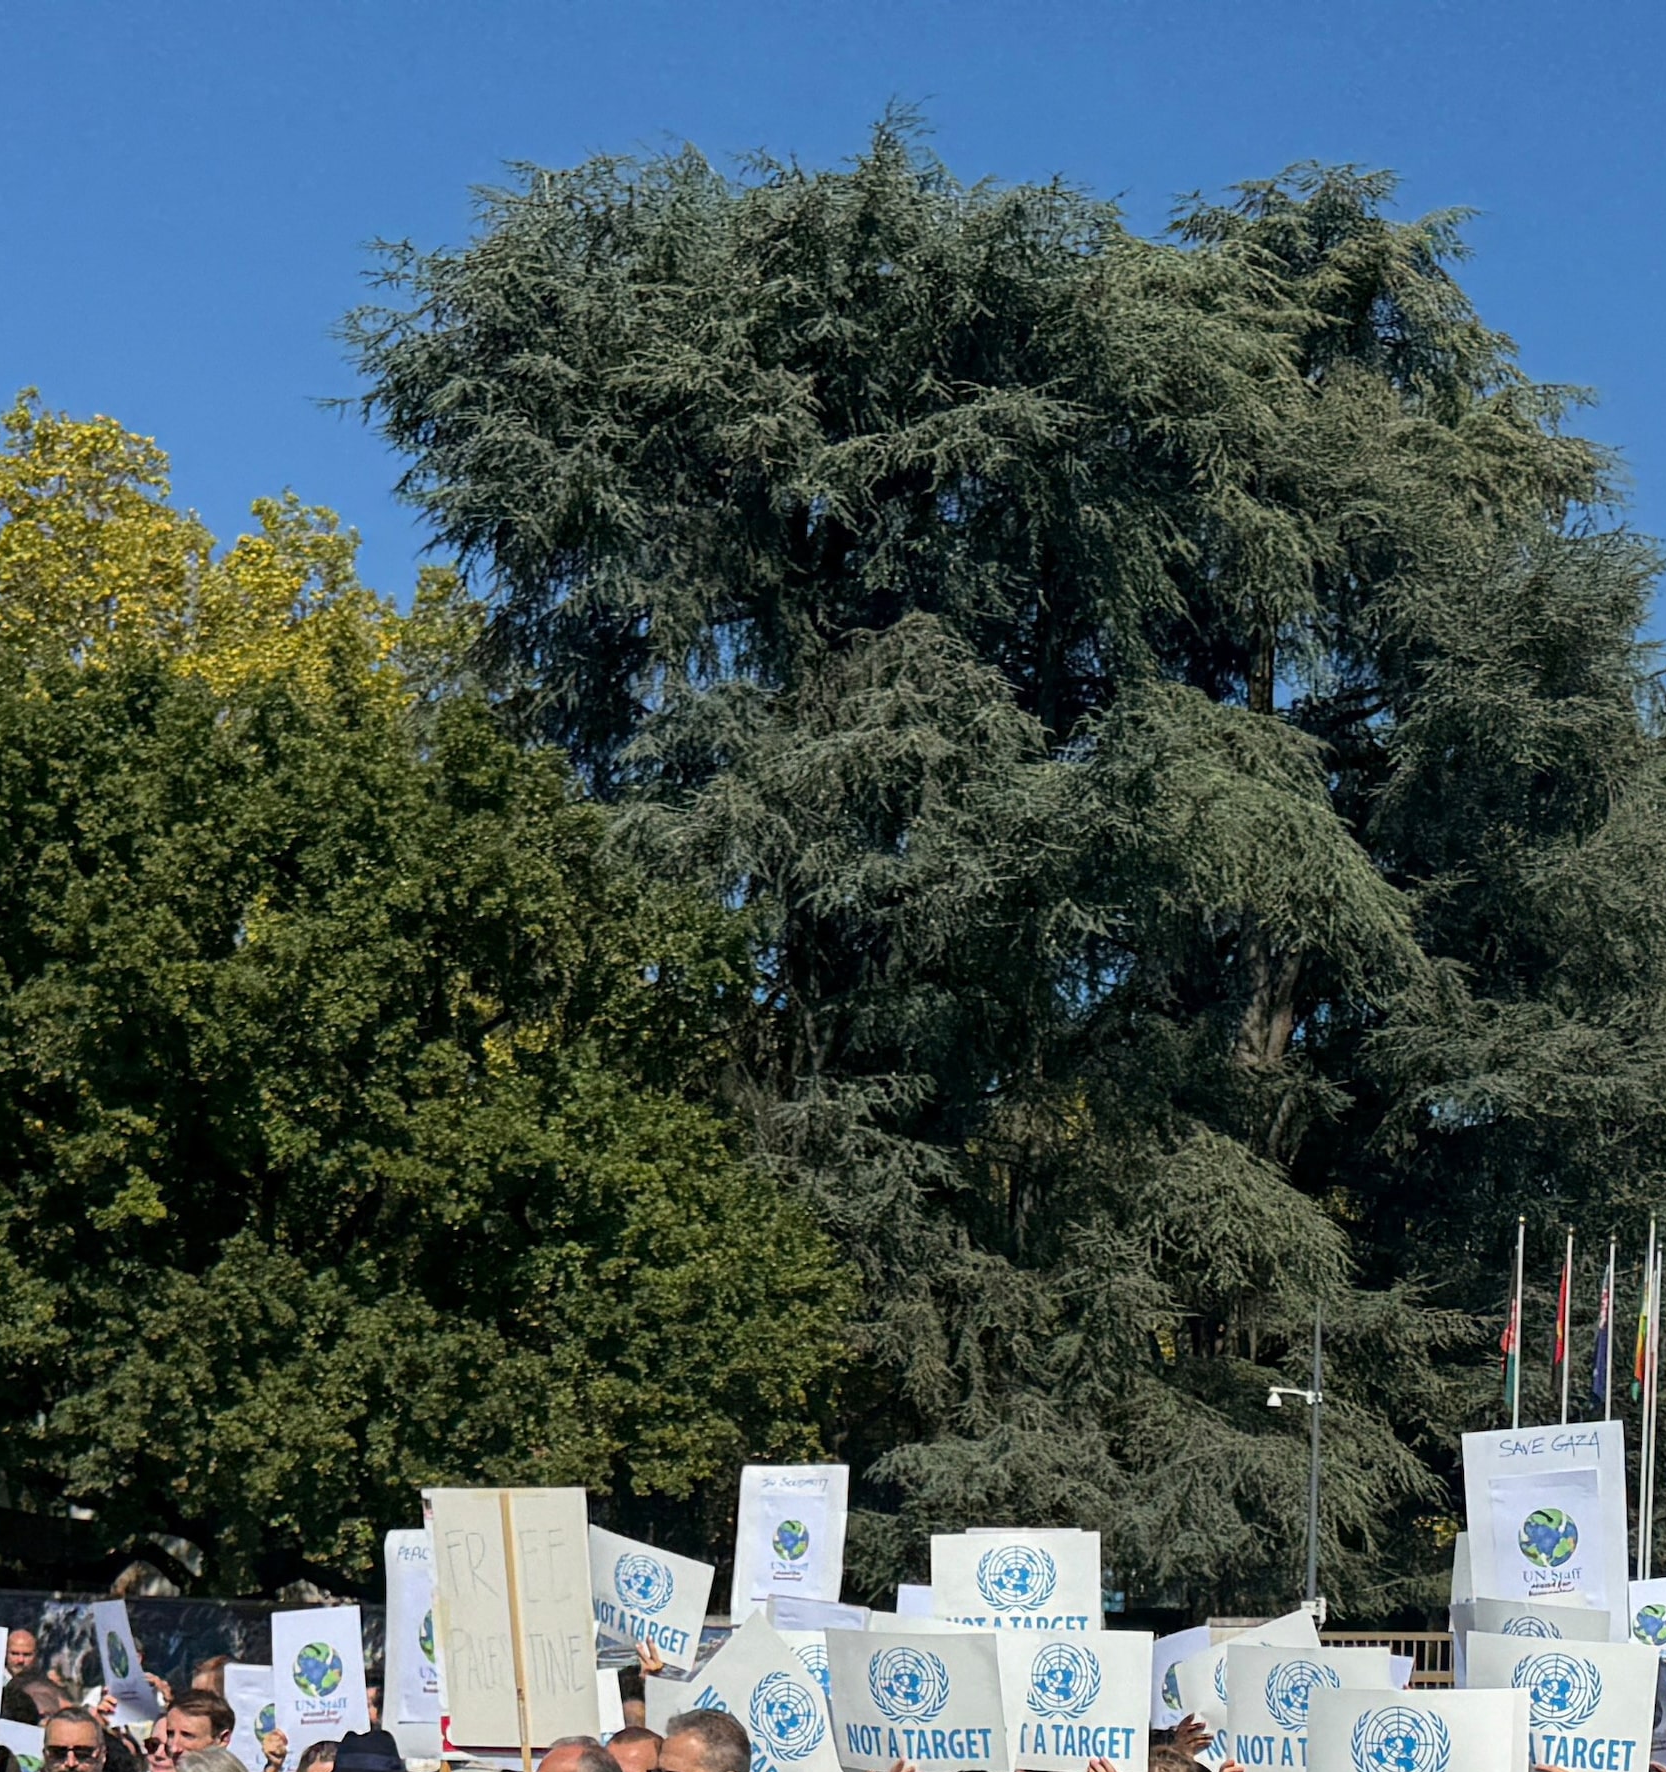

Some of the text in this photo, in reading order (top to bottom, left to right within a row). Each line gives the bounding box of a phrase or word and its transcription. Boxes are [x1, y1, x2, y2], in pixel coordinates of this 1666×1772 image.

[1499, 1431, 1601, 1459] SAVE GAZA
[397, 1545, 430, 1561] PEAC
[444, 1528, 574, 1604] FREE
[618, 1613, 628, 1634] A
[630, 1615, 691, 1656] TARGET
[846, 1723, 882, 1757] NOT
[888, 1727, 901, 1758] A
[902, 1727, 993, 1760] TARGET
[1033, 1723, 1046, 1755] A
[1052, 1725, 1136, 1760] TARGET
[1236, 1734, 1275, 1766] NOT
[1281, 1735, 1294, 1766] A
[1541, 1734, 1637, 1772] TARGET
